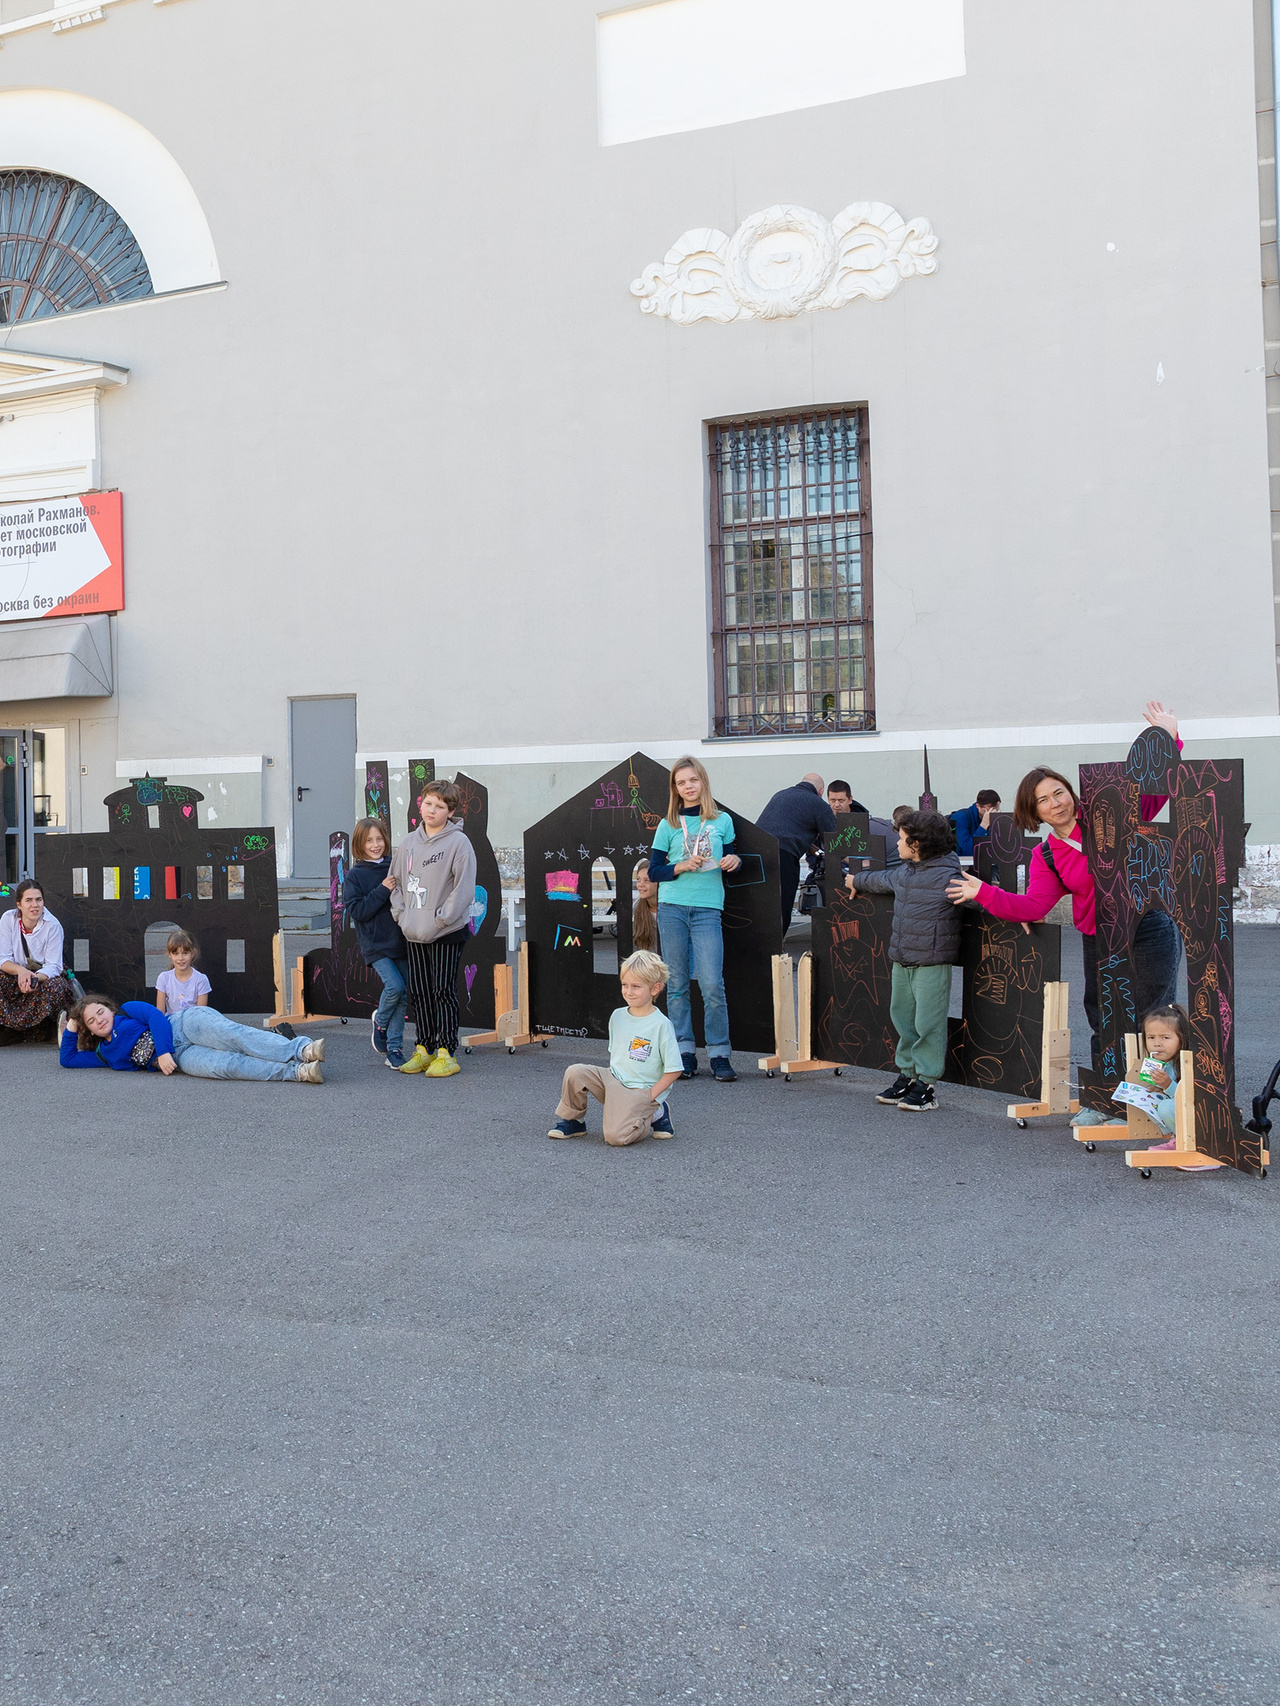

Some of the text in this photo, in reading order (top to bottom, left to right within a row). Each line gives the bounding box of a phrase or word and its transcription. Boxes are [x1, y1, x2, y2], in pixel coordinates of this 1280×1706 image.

[38, 504, 100, 522] Рахманов.
[16, 518, 87, 541] московской
[33, 595, 54, 609] без
[57, 592, 100, 609] окраин
[422, 851, 445, 868] SWEET!
